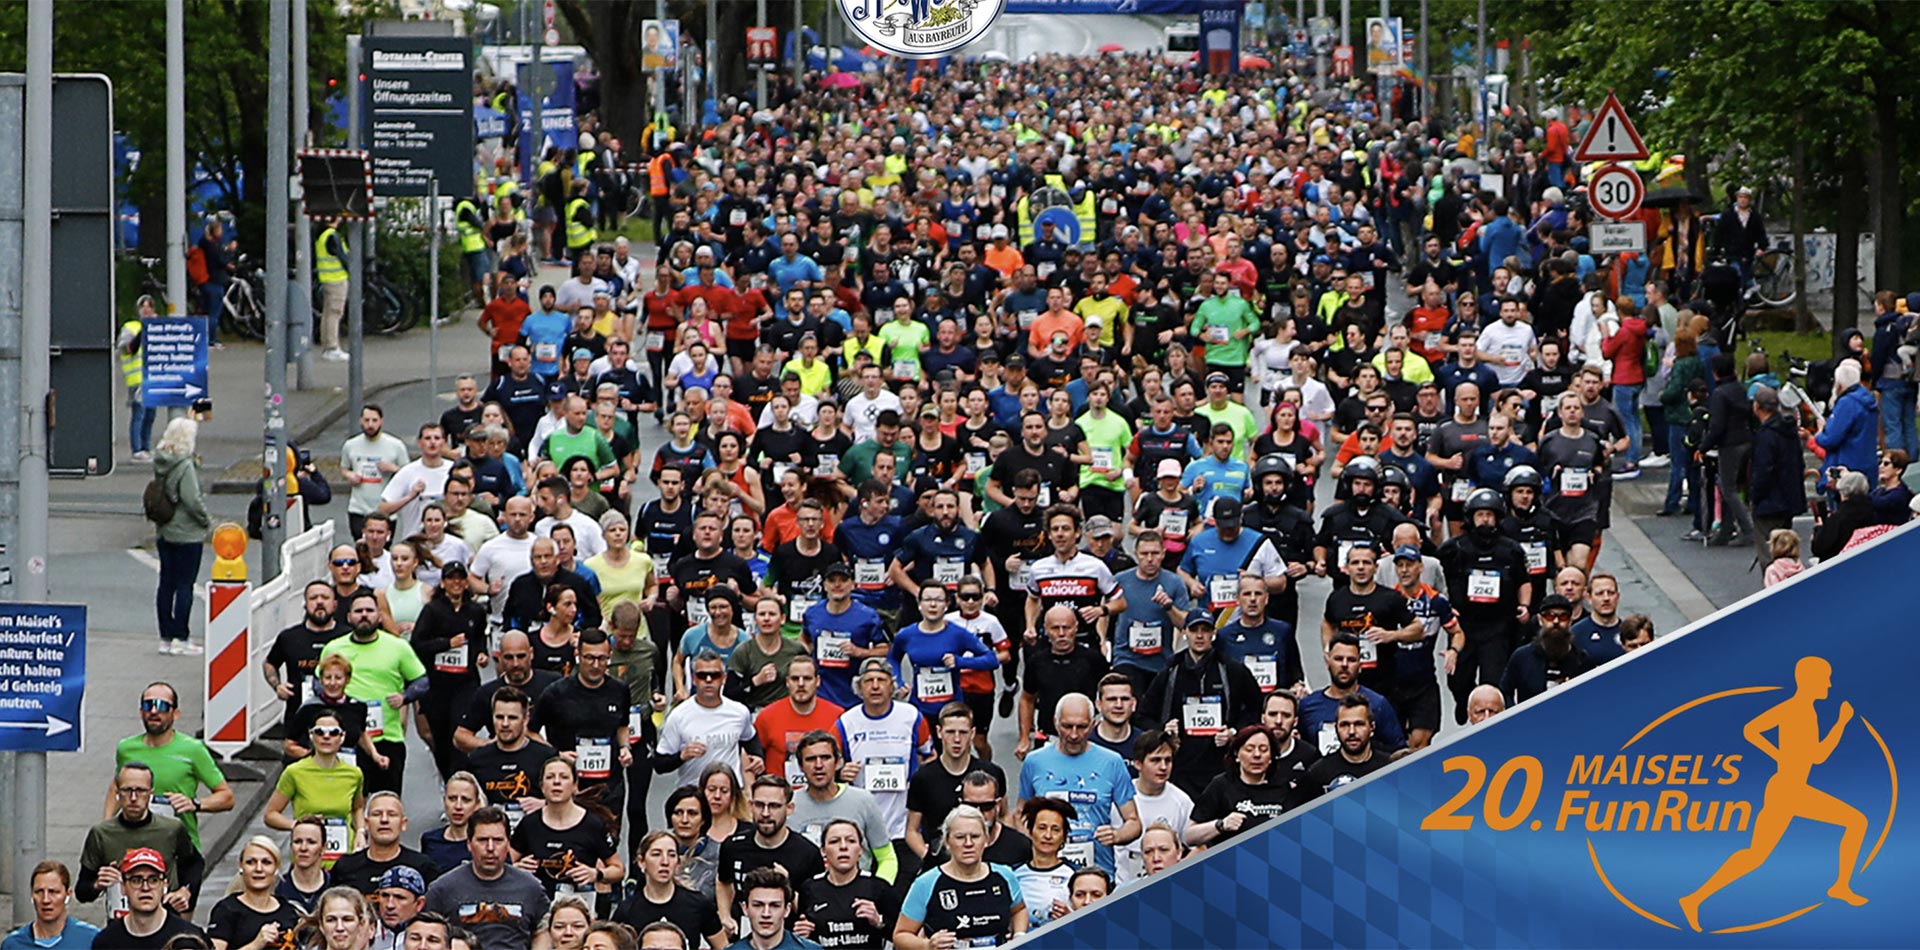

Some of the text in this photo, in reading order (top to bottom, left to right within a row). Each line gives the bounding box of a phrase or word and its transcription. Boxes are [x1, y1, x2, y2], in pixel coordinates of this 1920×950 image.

[1203, 10, 1236, 23] START
[373, 79, 410, 90] Unsere
[373, 90, 453, 105] Öffnungszeiten
[1600, 181, 1630, 205] 30
[16, 614, 62, 628] Maisel's
[36, 647, 64, 661] bitte
[441, 655, 462, 665] 1431
[24, 663, 62, 677] halten
[12, 679, 63, 696] Gehsteig
[923, 684, 948, 695] 1244
[1191, 715, 1216, 727] 1580
[582, 758, 606, 770] 1617
[872, 777, 899, 789] 2618
[828, 920, 854, 933] Team
